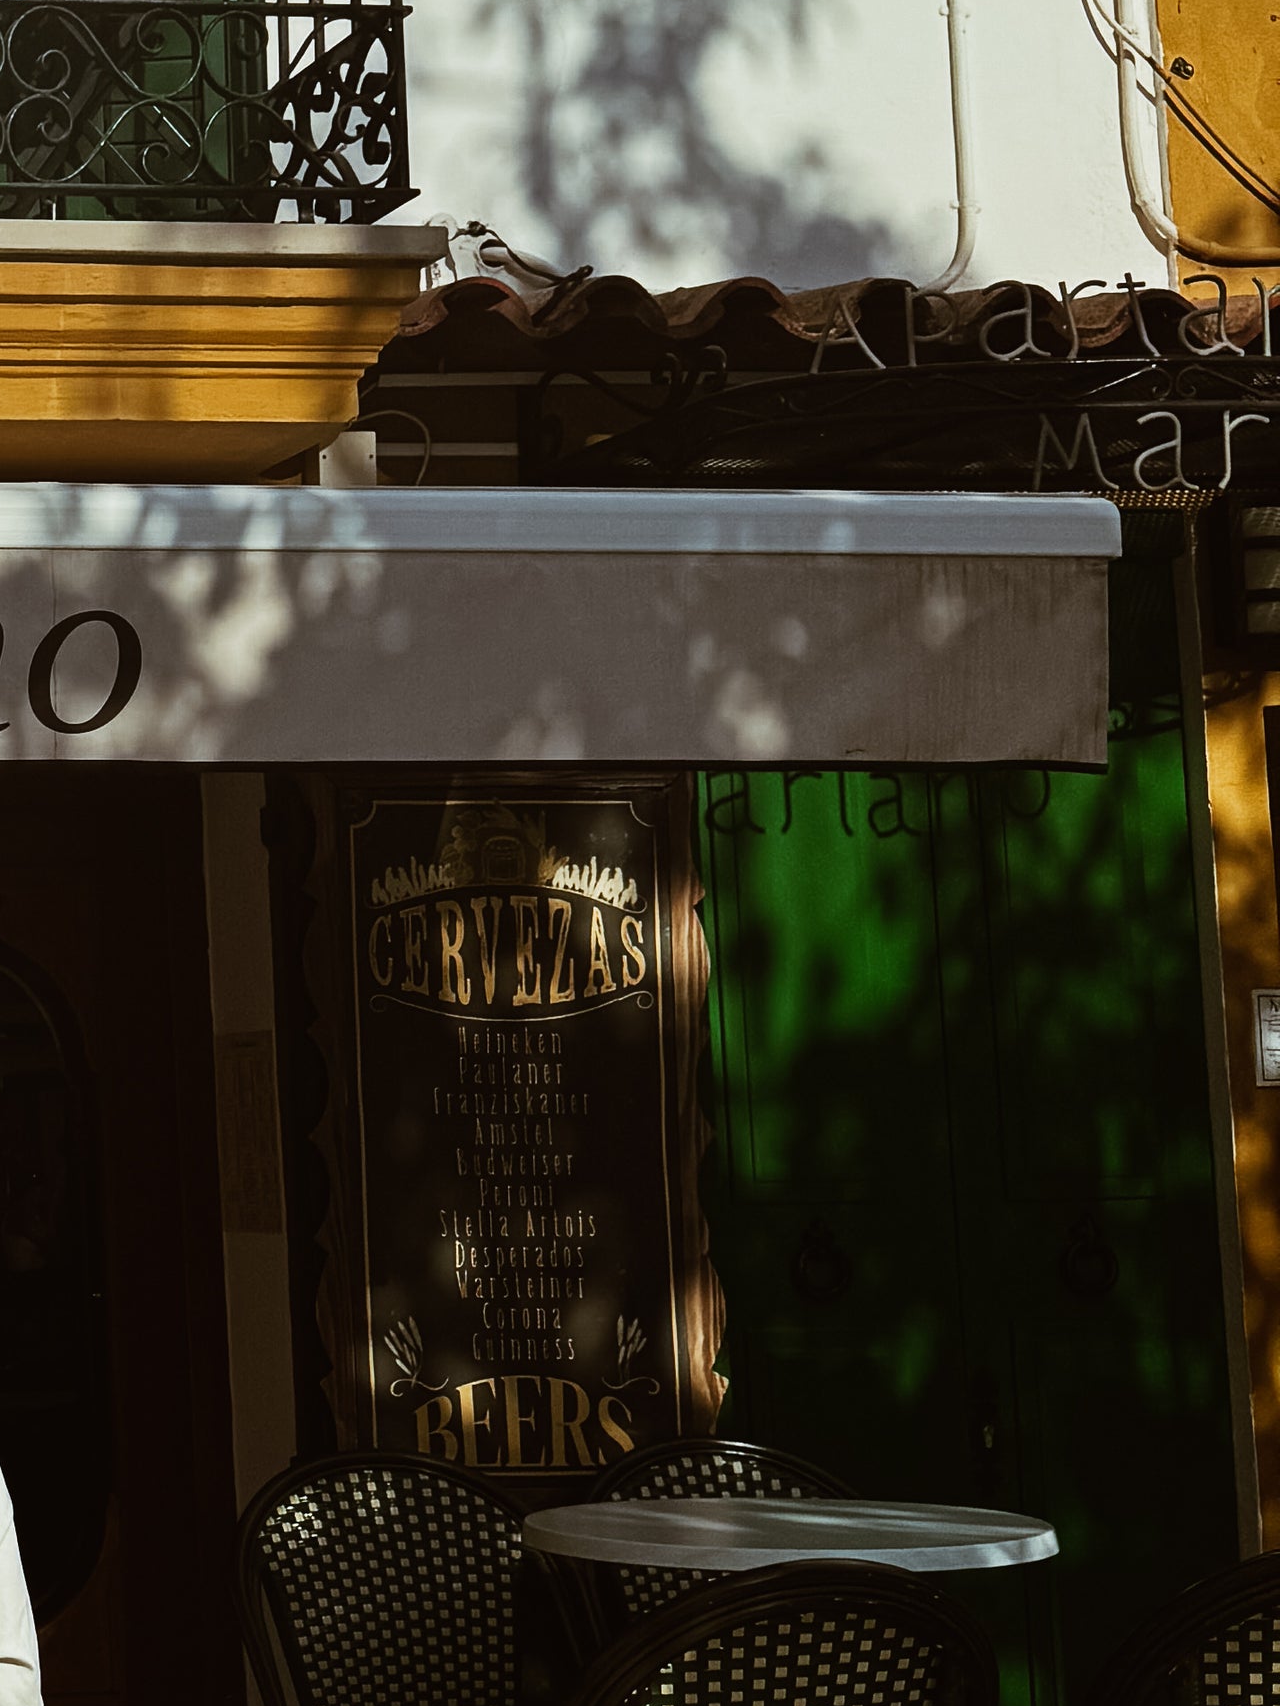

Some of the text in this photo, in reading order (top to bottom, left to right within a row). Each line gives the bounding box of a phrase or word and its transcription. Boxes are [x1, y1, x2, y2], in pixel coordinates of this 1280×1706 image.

[368, 895, 647, 1006] CERVEZAS
[459, 1026, 562, 1054] Heineken
[460, 1056, 562, 1085] Paulaner
[475, 1118, 553, 1145] Amstel
[457, 1148, 573, 1176] Budweiser
[480, 1178, 552, 1206] Peroni
[440, 1210, 597, 1237] Stella Artois
[455, 1240, 584, 1274] Desperados
[456, 1270, 584, 1299] Warsteiner
[483, 1302, 561, 1330] Corona
[472, 1333, 575, 1361] Guinness
[414, 1374, 635, 1467] BEERS
